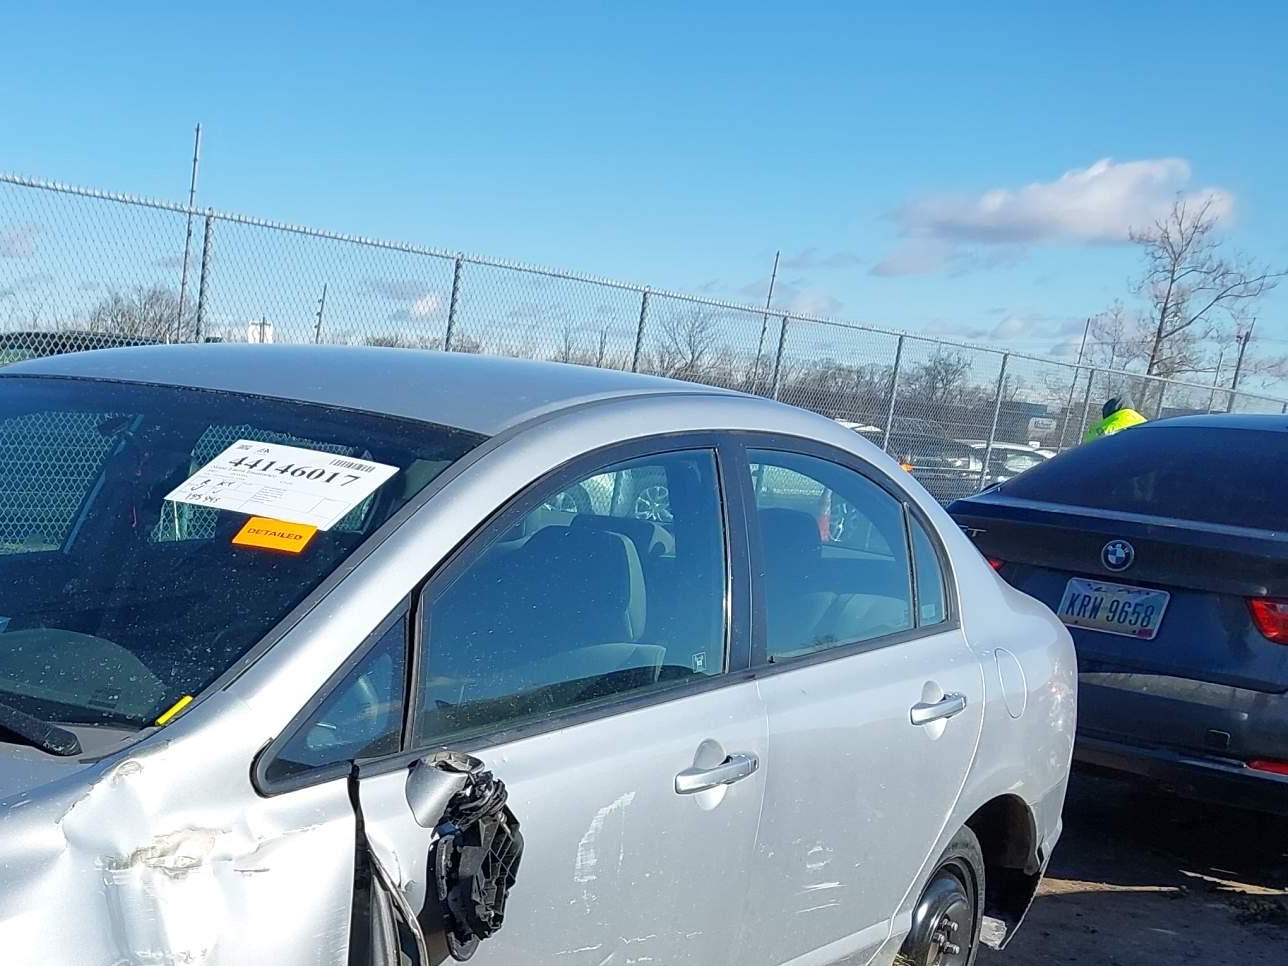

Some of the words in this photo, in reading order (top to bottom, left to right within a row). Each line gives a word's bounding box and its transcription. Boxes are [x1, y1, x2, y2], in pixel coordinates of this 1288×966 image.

[228, 456, 360, 487] 44146017
[247, 528, 303, 541] DETAILED
[1065, 592, 1104, 620] KRW
[1106, 599, 1155, 628] 9658
